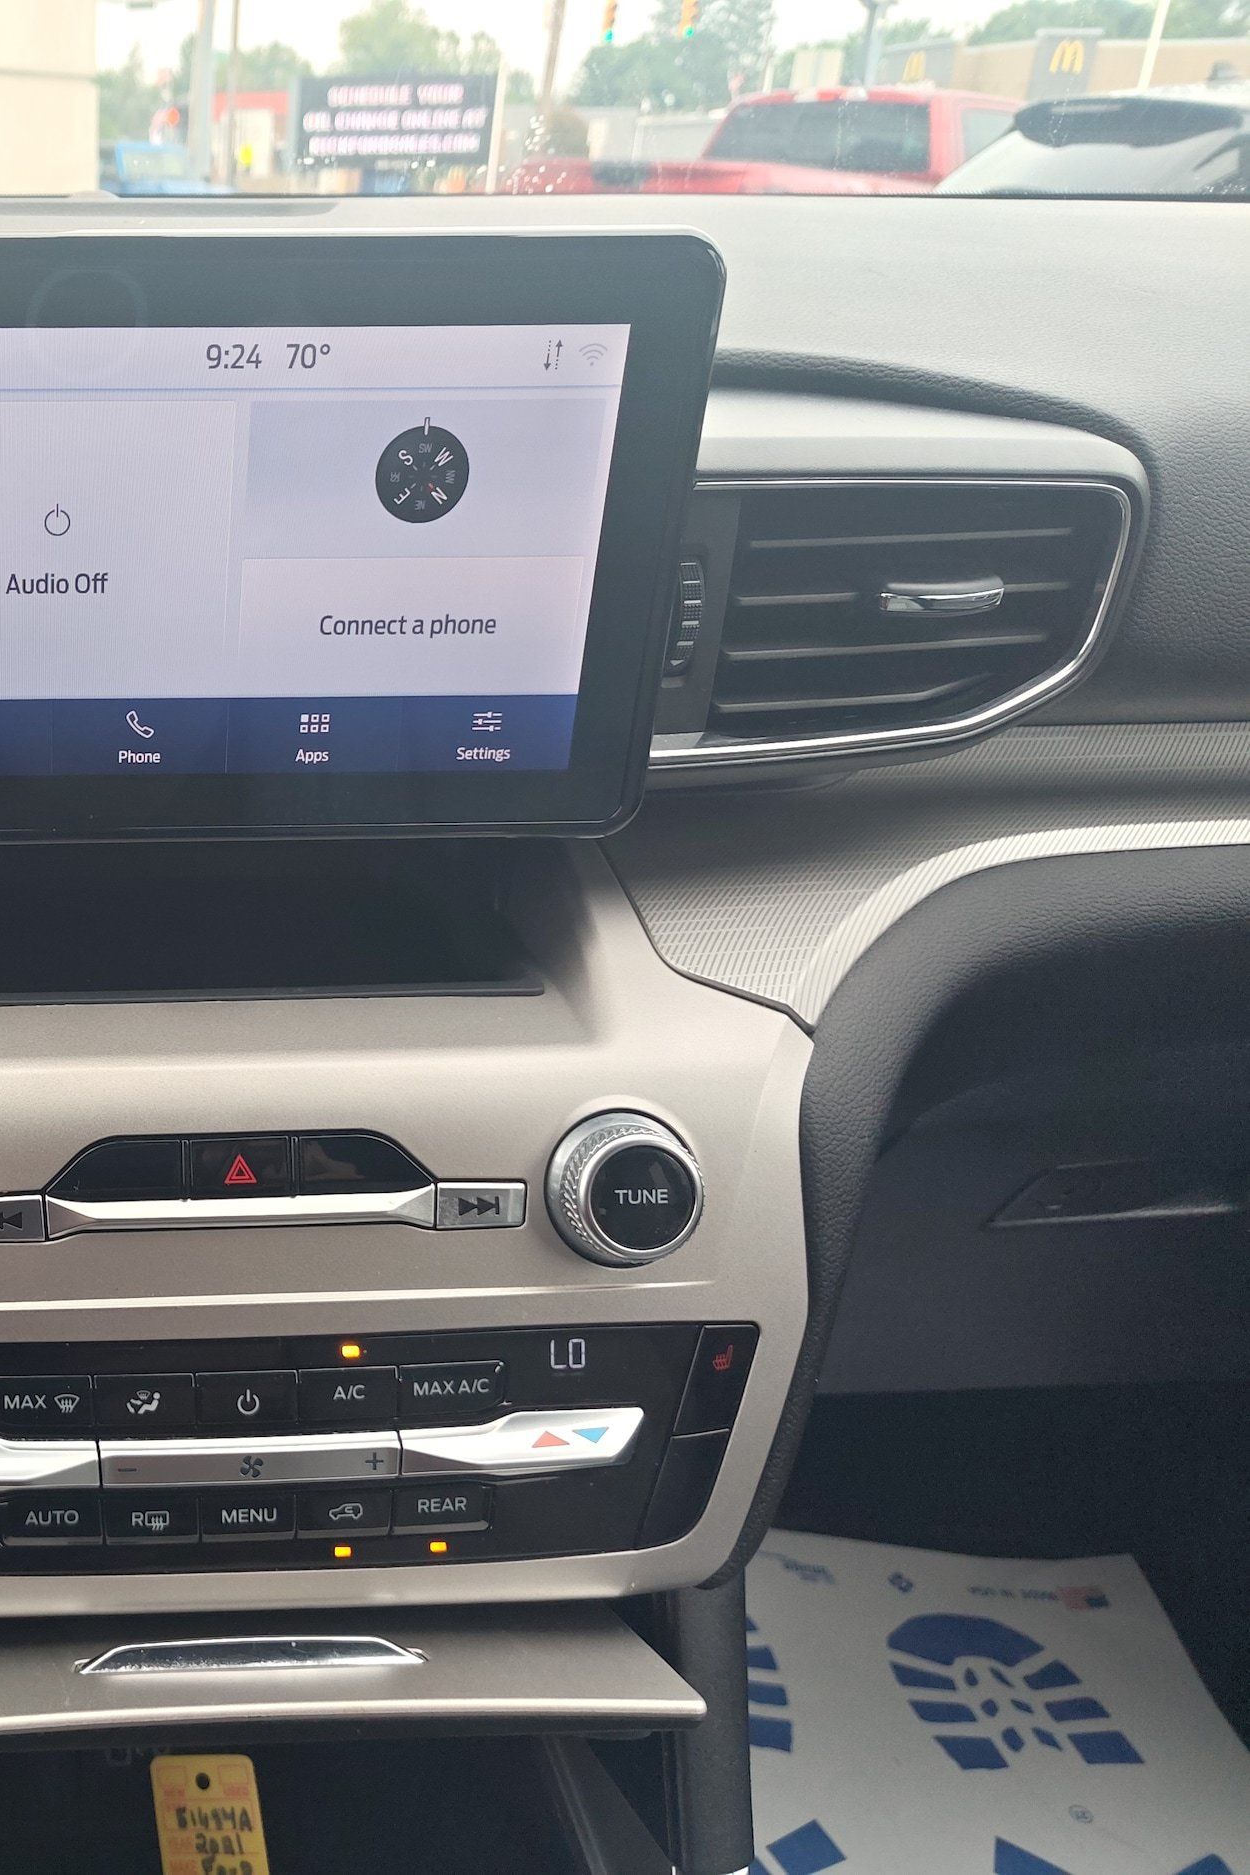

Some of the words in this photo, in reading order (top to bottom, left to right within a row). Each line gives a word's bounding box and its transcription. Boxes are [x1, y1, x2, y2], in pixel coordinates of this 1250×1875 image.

[206, 344, 262, 369] 9:24
[286, 344, 331, 369] 70°
[6, 573, 69, 594] Audio
[75, 572, 108, 594] Off
[320, 615, 407, 635] Connect
[412, 619, 424, 634] a
[430, 614, 497, 638] phone
[118, 750, 161, 763] Phone
[295, 749, 329, 764] Apps
[456, 746, 511, 762] Settings
[614, 1189, 669, 1205] TUNE
[550, 1338, 586, 1369] LO
[333, 1384, 366, 1400] A/C
[413, 1380, 454, 1396] MAX
[458, 1378, 490, 1394] A/C
[4, 1395, 47, 1410] MAX
[417, 1497, 467, 1513] REAR
[25, 1510, 80, 1526] AUTO
[221, 1507, 277, 1524] MENU
